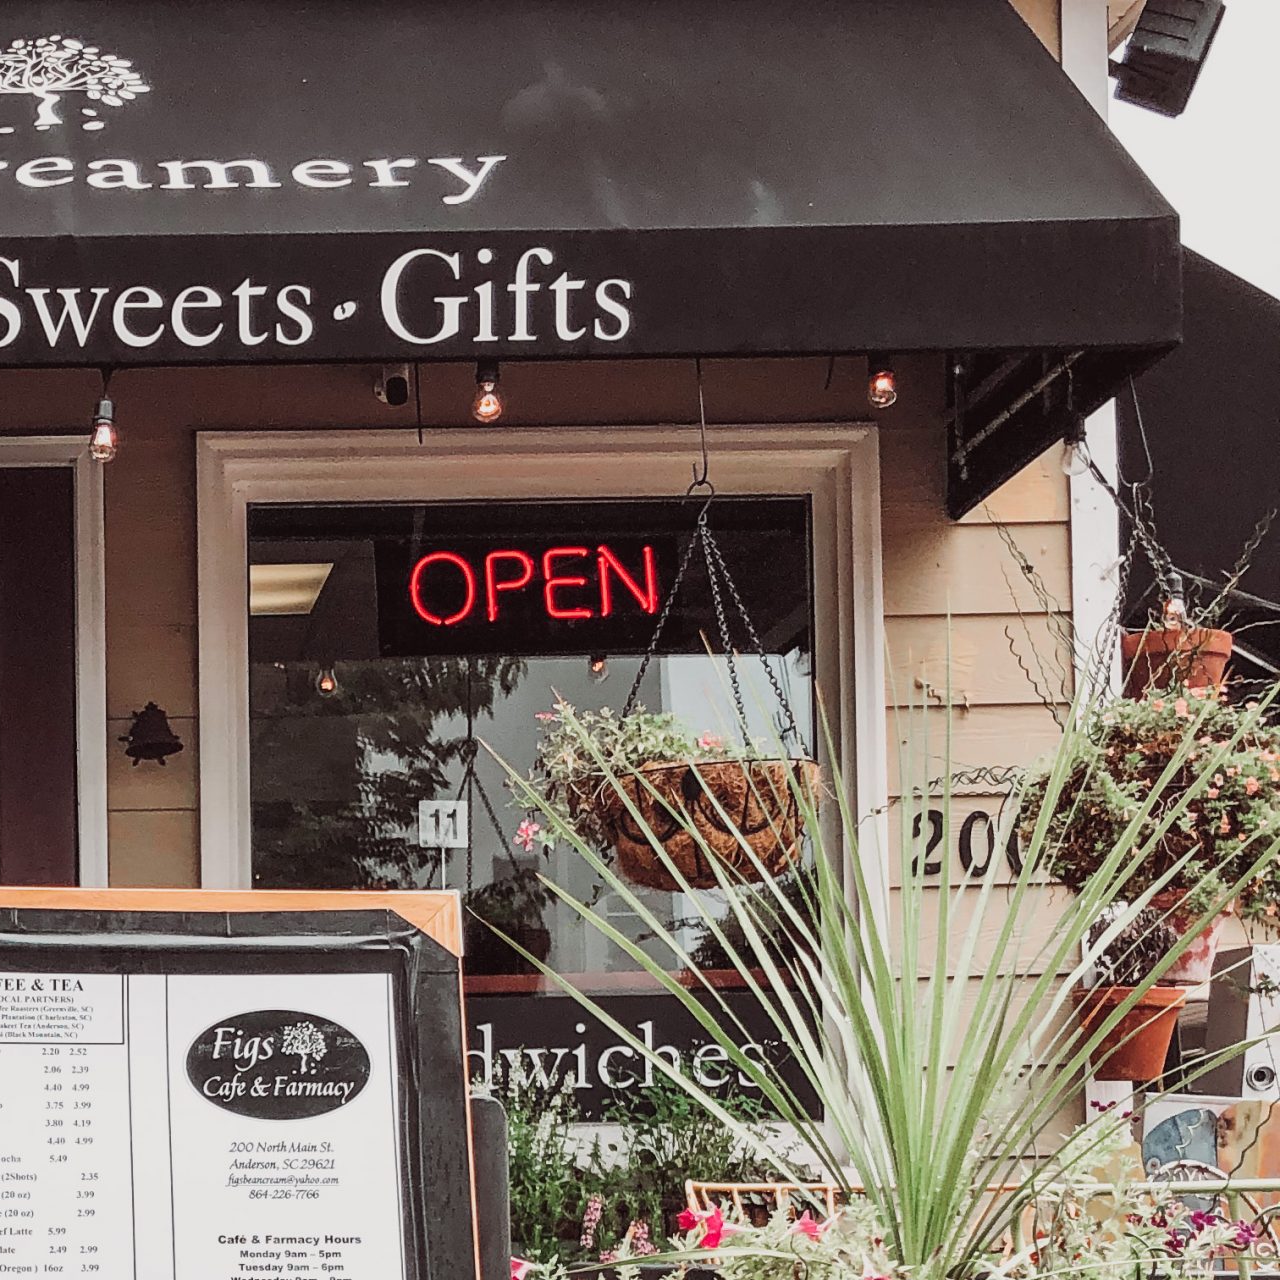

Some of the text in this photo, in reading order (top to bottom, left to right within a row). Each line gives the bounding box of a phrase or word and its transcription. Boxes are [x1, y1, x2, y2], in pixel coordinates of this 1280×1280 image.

[379, 247, 634, 346] Gifts
[410, 545, 658, 625] OPEN
[428, 808, 458, 840] 11
[30, 978, 45, 992] &
[49, 978, 84, 992] TEA
[41, 1047, 60, 1056] 2.20
[68, 1047, 88, 1056] 2.52
[210, 1025, 275, 1072] Figs
[467, 1021, 766, 1090] dwiches
[202, 1072, 356, 1105] Cafe & Farmacy
[45, 1101, 64, 1110] 3.75
[73, 1100, 92, 1110] 3.99
[228, 1141, 255, 1153] 200
[255, 1140, 288, 1153] North
[287, 1141, 318, 1154] Main
[228, 1158, 335, 1171] Anderson, SC 29621
[248, 1188, 320, 1200] 864-226-7766
[250, 1234, 261, 1245] &
[265, 1234, 320, 1247] Farmacy
[324, 1234, 362, 1245] Hours
